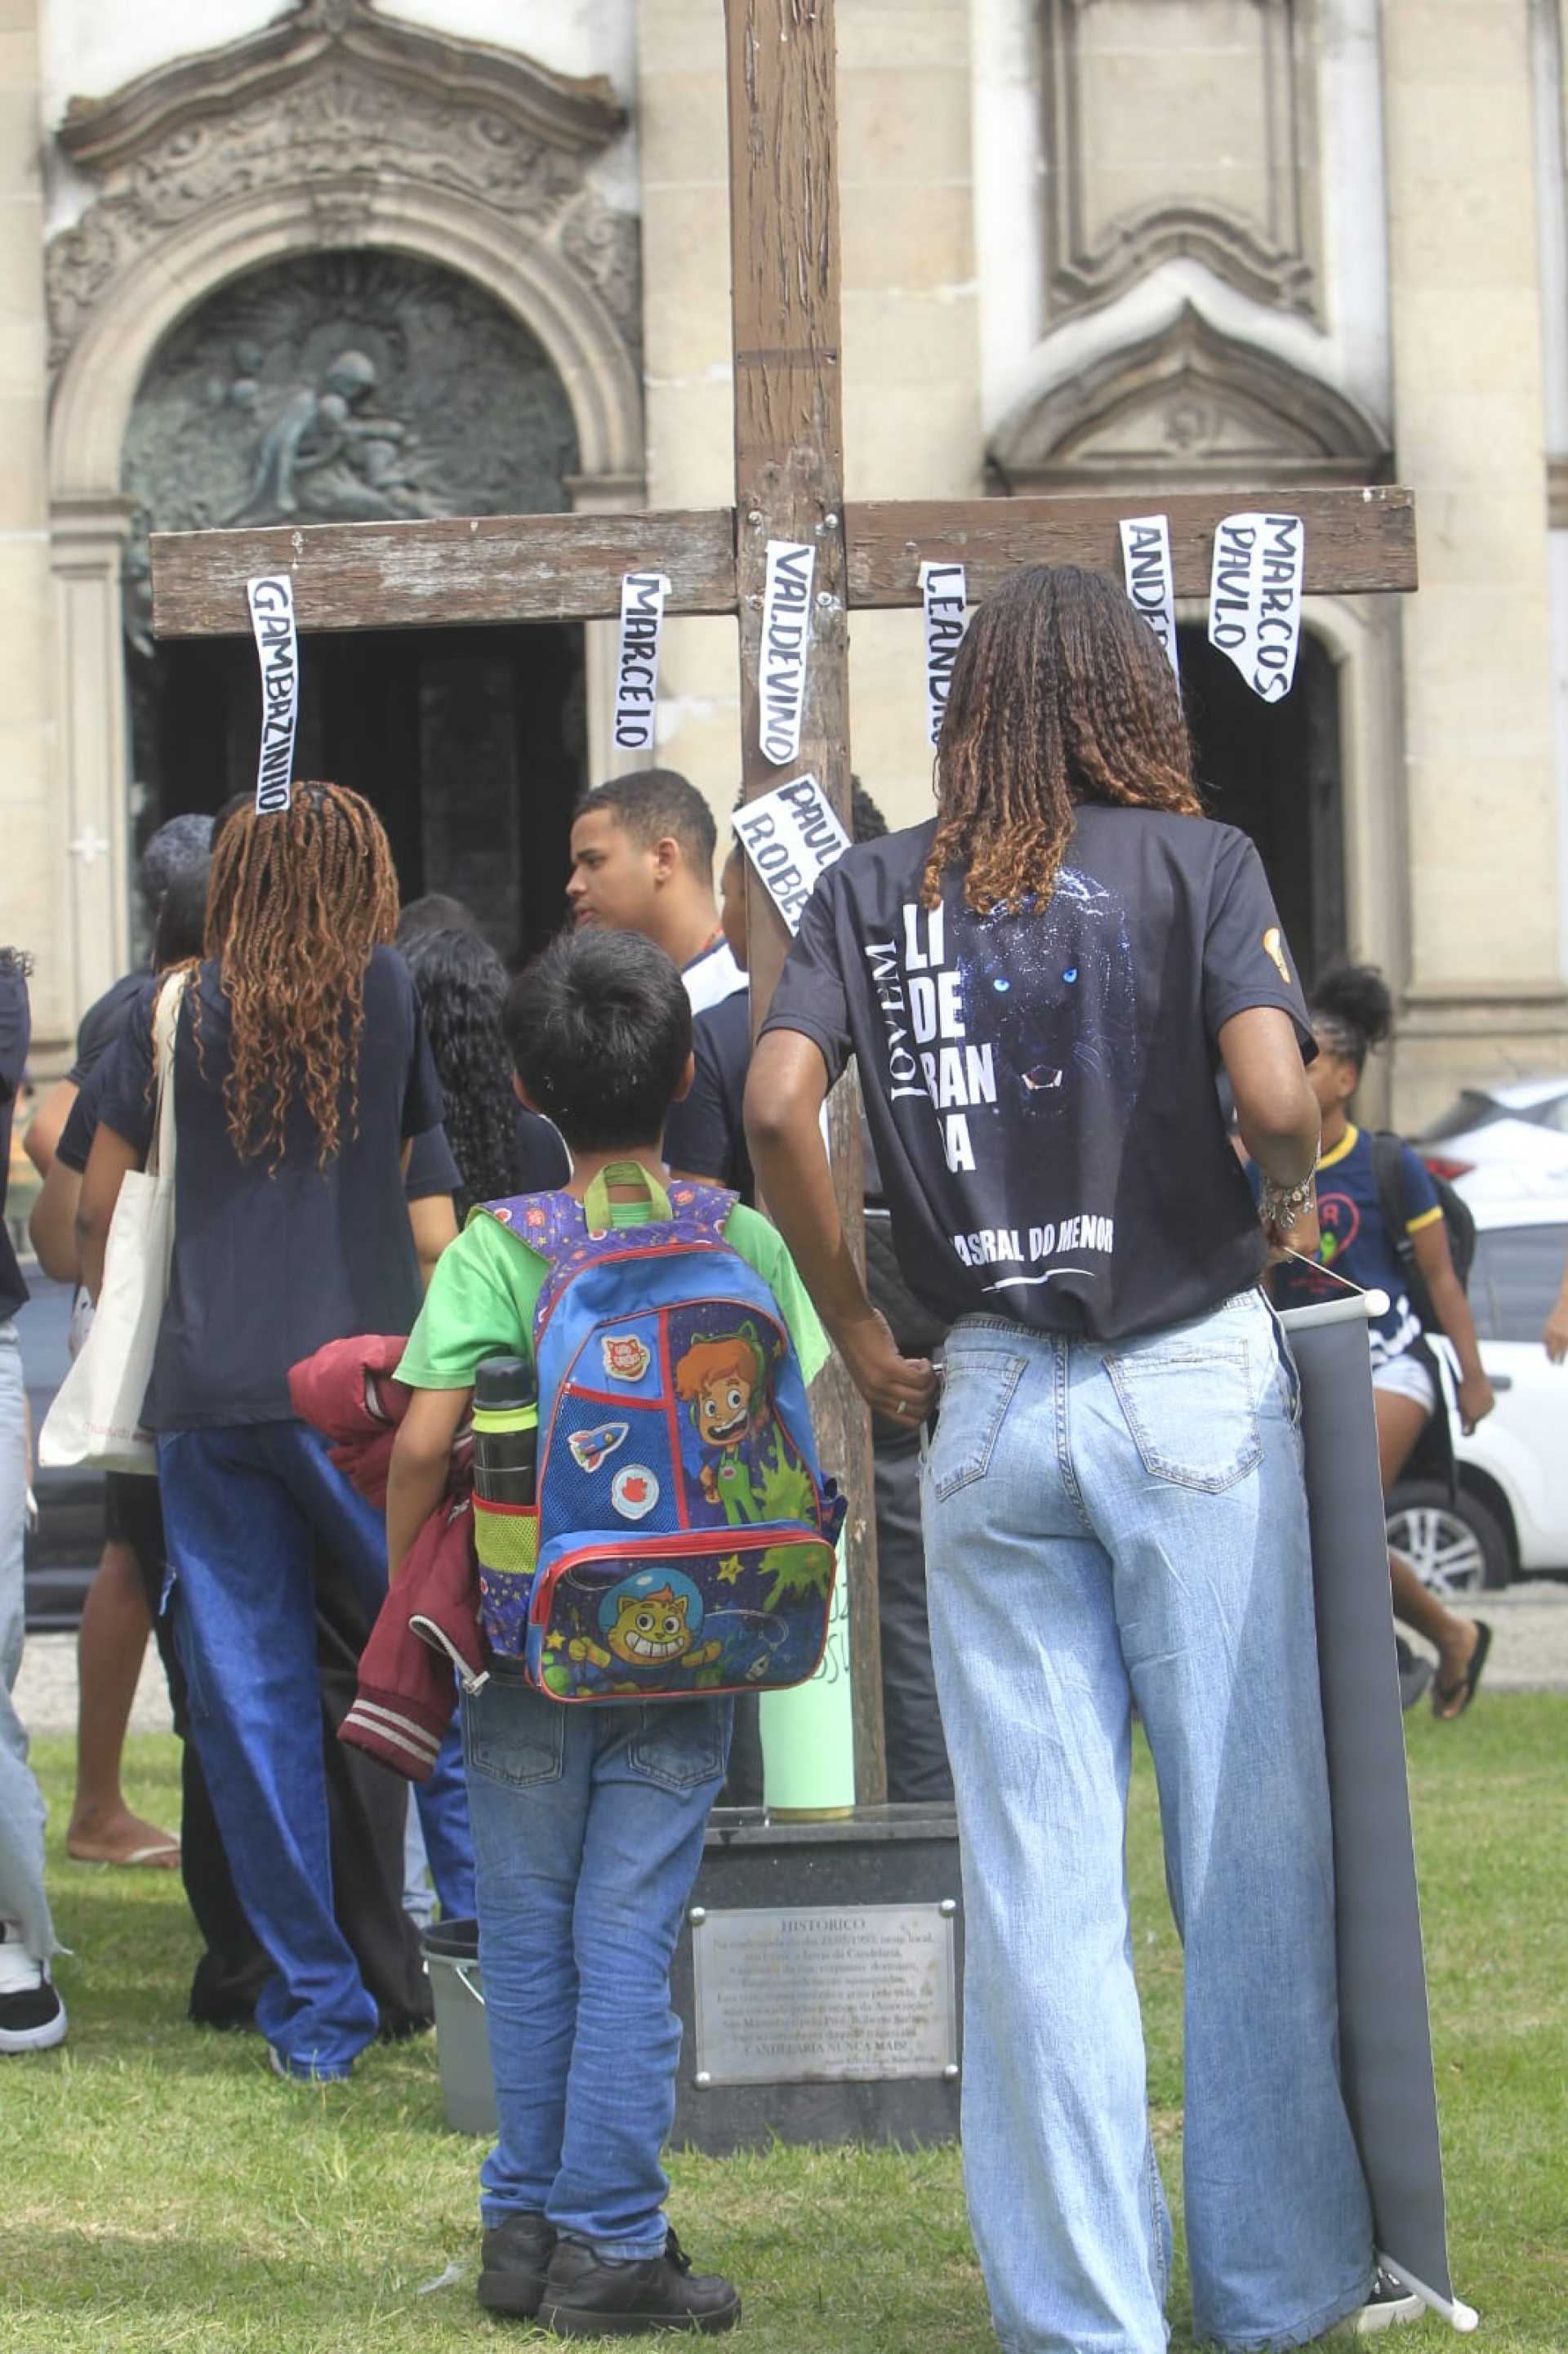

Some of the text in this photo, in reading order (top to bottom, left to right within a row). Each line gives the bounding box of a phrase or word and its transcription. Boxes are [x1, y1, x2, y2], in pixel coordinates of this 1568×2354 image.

[1213, 524, 1257, 649] PAULO
[1254, 517, 1298, 695] MARCOS
[616, 576, 660, 747] MARCELO
[765, 548, 810, 760] VALDEVINO
[742, 812, 809, 928] ROBE
[903, 899, 945, 971] LI
[865, 939, 931, 1102] JOVEM
[907, 970, 966, 1044] DE
[920, 1042, 997, 1110] RAN
[938, 1113, 978, 1174] A
[1029, 1224, 1055, 1262] DO
[1057, 1215, 1114, 1254] MENOR
